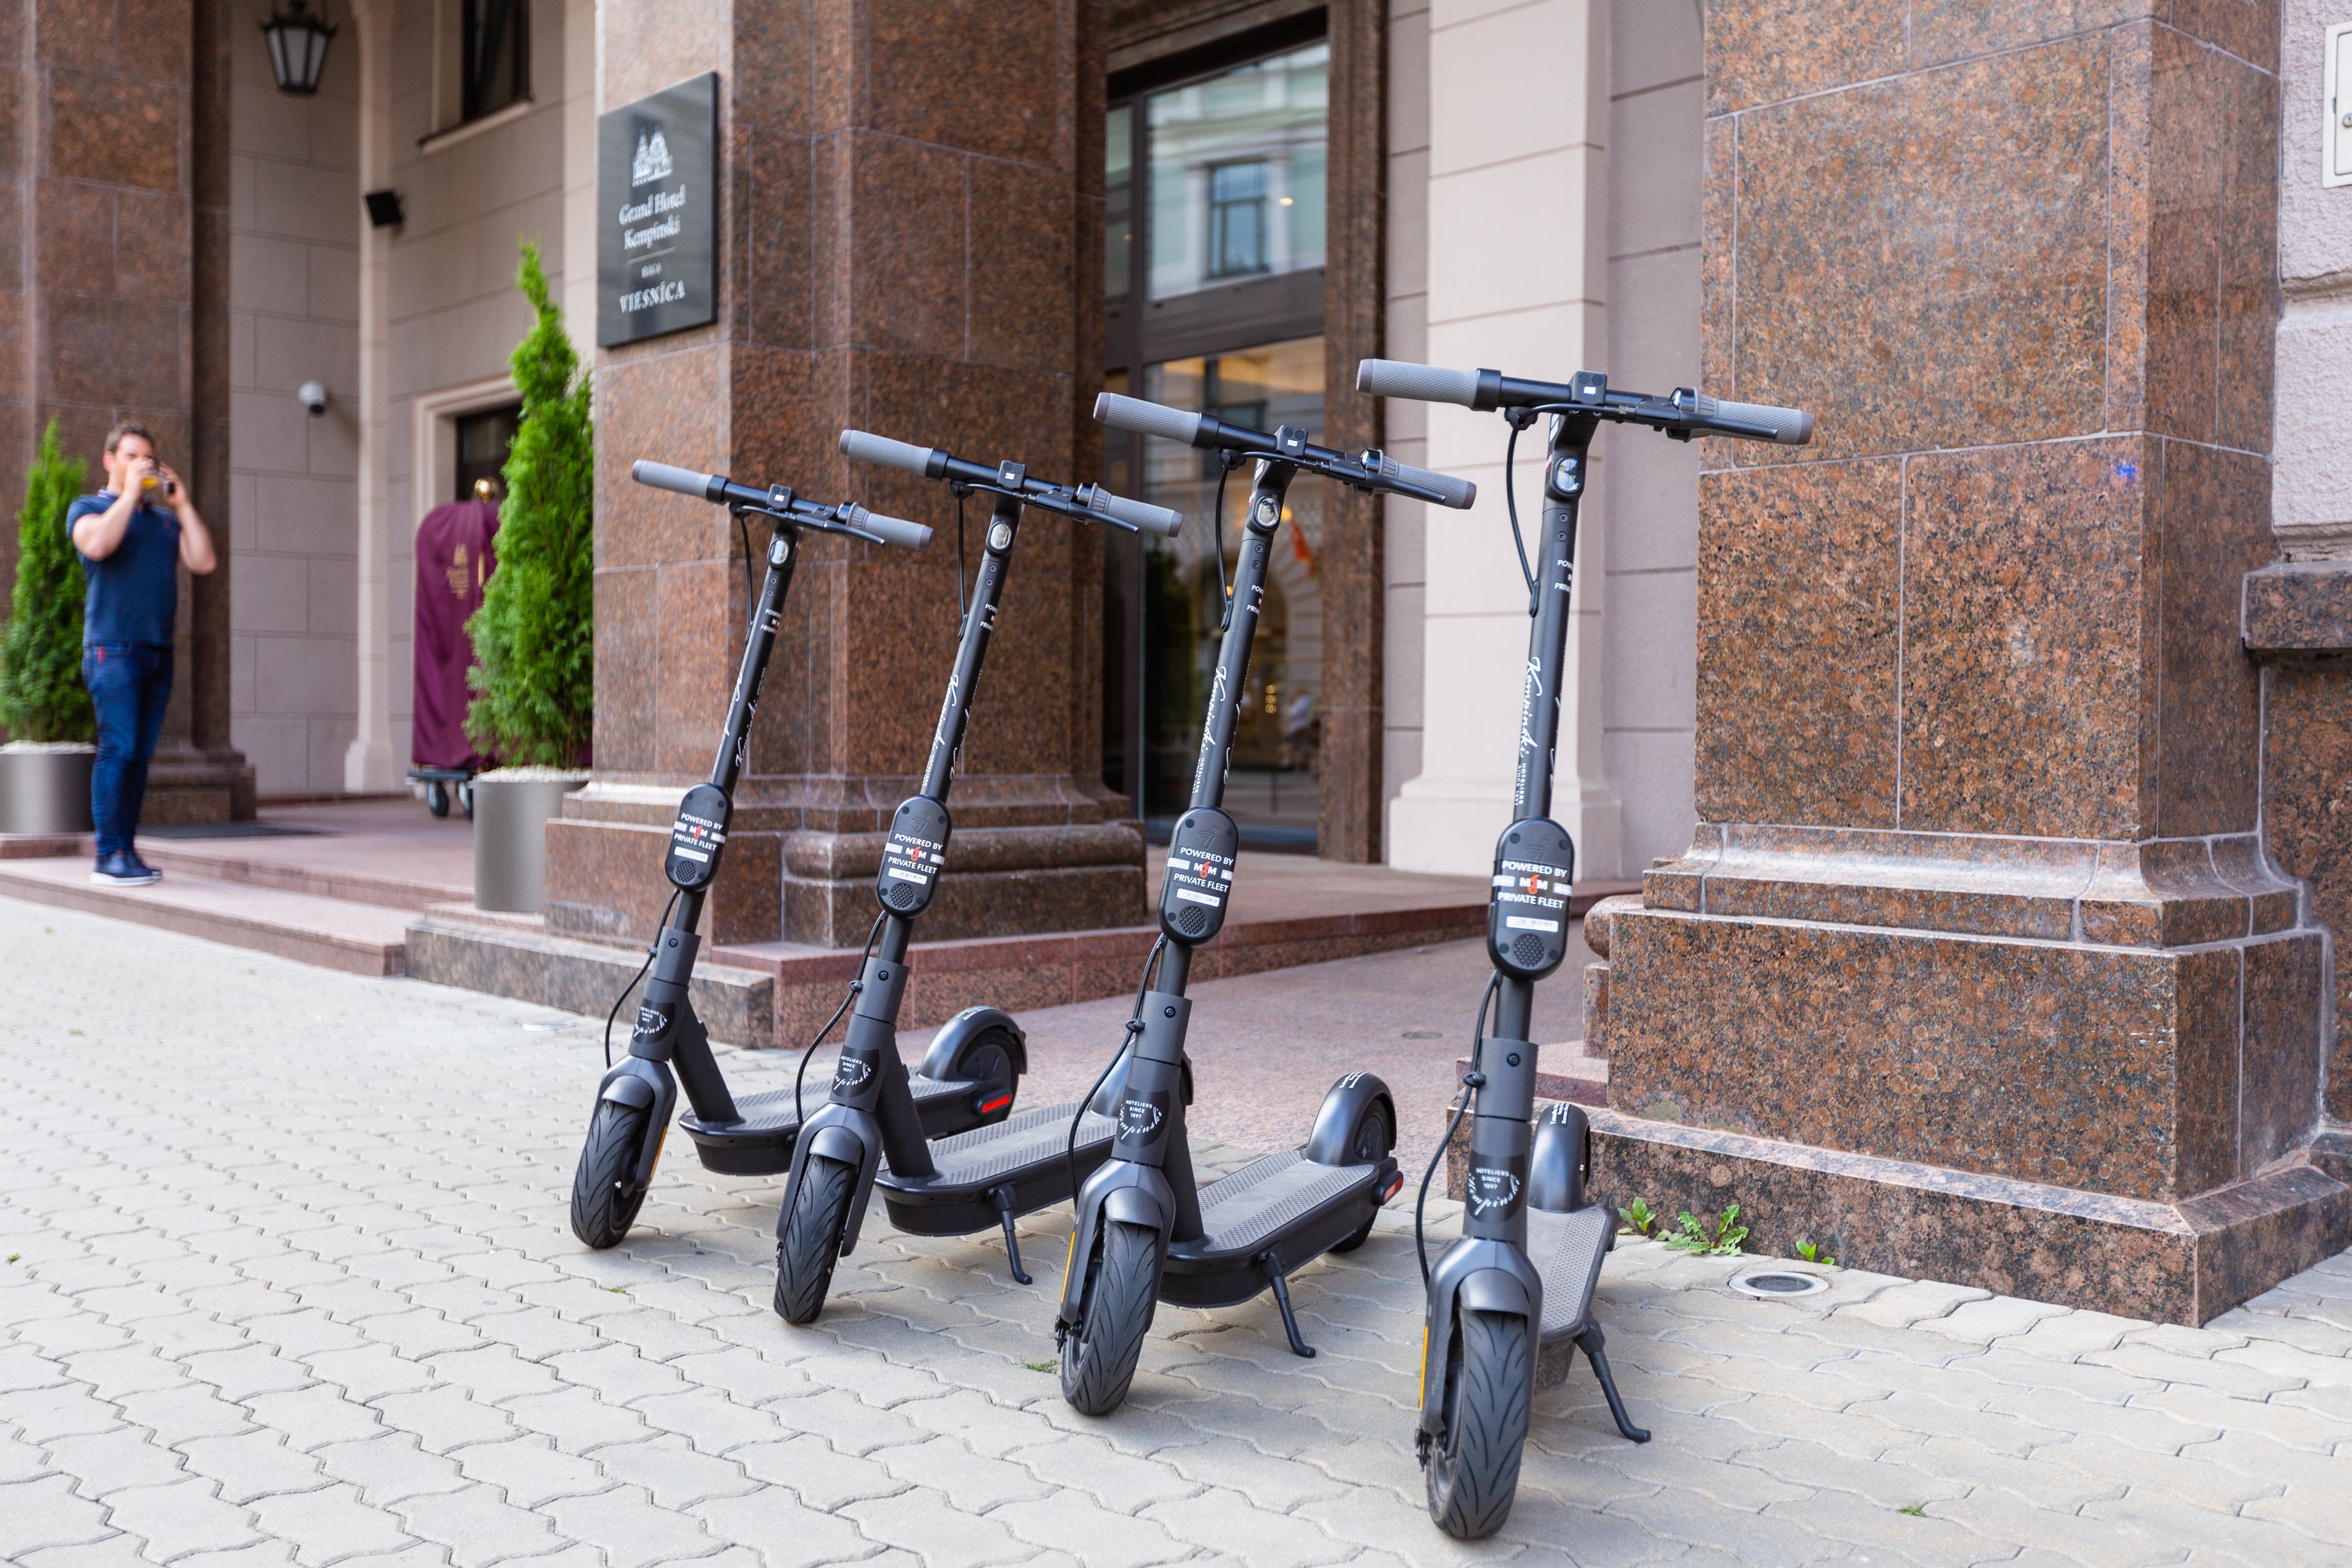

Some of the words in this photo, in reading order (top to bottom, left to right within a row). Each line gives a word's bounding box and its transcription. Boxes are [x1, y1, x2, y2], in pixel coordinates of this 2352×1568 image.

[619, 194, 654, 225] Grand
[655, 183, 685, 214] Hotel
[624, 214, 680, 250] Kempinski
[681, 812, 713, 827] POWERED
[714, 822, 723, 831] BY
[674, 832, 698, 846] PRIVATE
[698, 840, 717, 851] FLEET
[894, 833, 932, 848] POWERED
[932, 842, 943, 851] BY
[1180, 847, 1222, 862] POWERED
[1223, 857, 1234, 865] BY
[888, 856, 916, 869] PRIVATE
[917, 863, 938, 875] FLEET
[1501, 861, 1553, 875] POWERED
[1553, 868, 1568, 878] BY
[1174, 873, 1207, 887] PRIVATE
[1207, 881, 1229, 892] FLEET
[1497, 892, 1537, 905] PRIVATE
[1537, 896, 1565, 909] FLEET
[840, 1055, 862, 1065] HOTELIERS
[1125, 1099, 1152, 1109] HOTELIERS
[1476, 1167, 1510, 1177] HOTELIERS
